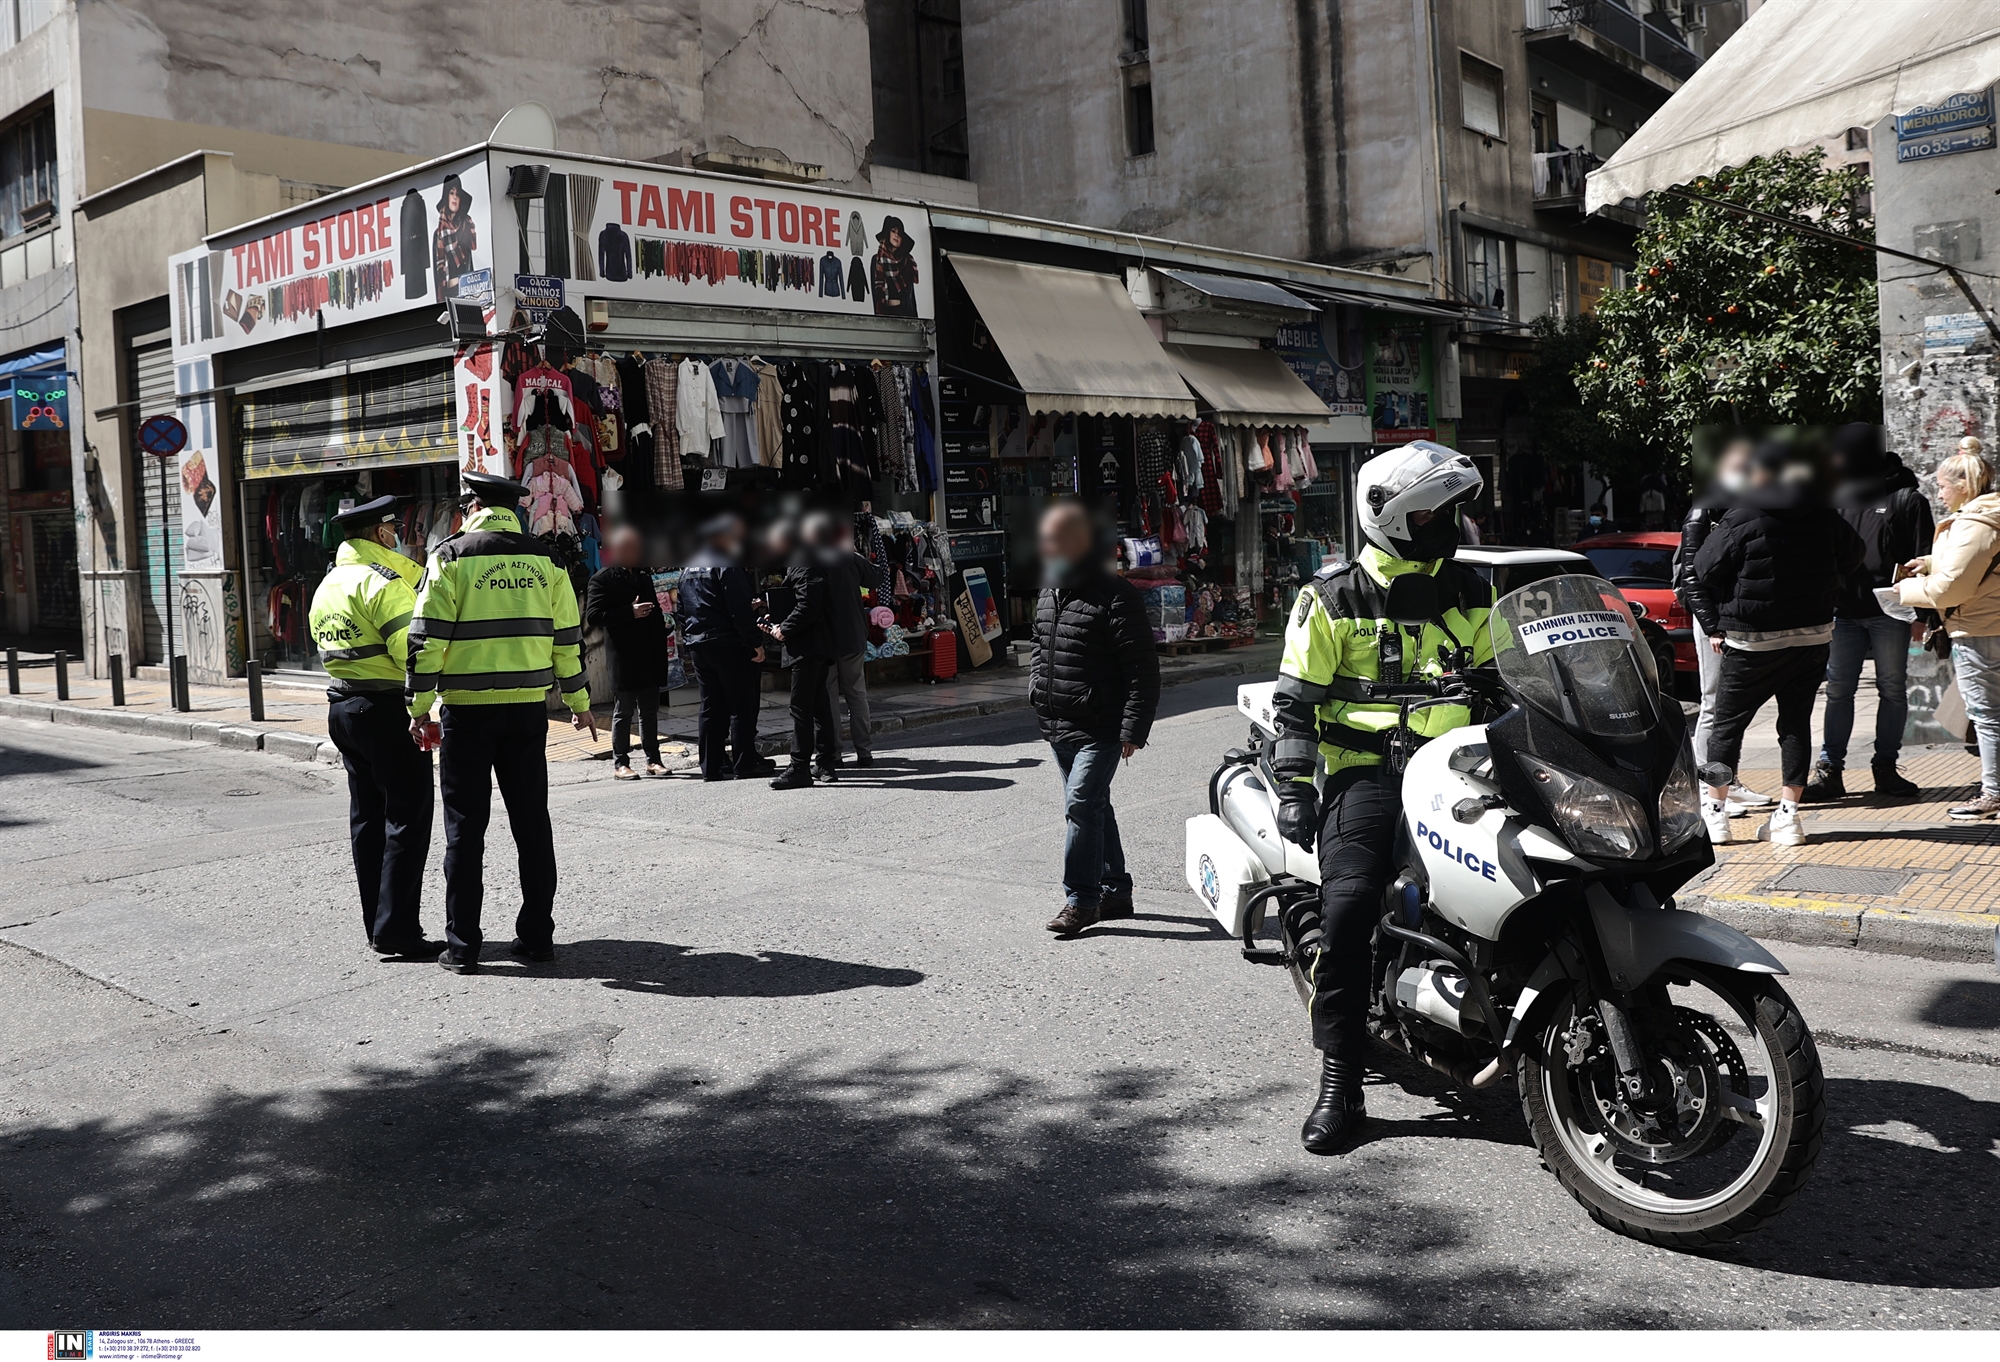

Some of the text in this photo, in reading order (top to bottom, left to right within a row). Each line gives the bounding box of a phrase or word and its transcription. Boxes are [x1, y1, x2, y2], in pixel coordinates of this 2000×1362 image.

[1903, 106, 1986, 130] MENANDROU
[1902, 131, 1990, 158] ΑΠΟ 53 55
[613, 179, 841, 248] TAMI STORE
[232, 197, 392, 290] TAMI STORE
[466, 274, 481, 284] ΟΔΟΣ
[529, 279, 550, 287] ΟΔΟΣ
[520, 286, 561, 297] ΖΗΝΩΝΟΣ
[521, 297, 560, 307] ZINONOS
[533, 312, 544, 322] 13
[1301, 362, 1315, 370] Mobile
[1373, 366, 1390, 374] MOBILE
[1395, 367, 1411, 375] LAPTOP
[1376, 376, 1387, 384] SALE
[1392, 376, 1410, 385] SERVICE
[487, 514, 512, 522] POLICE
[474, 561, 548, 590] ΕΛΛΗΝΙΚΗ ΑΣΤΥΝΟΜΙΑ
[490, 578, 533, 589] POLICE
[1521, 612, 1625, 636] ΕΛΛΗΝΙΚΗ ΑΣΤΥΝΟΜΙΑ
[319, 629, 352, 643] POLICE
[1353, 624, 1389, 638] POLICE
[1547, 626, 1620, 645] POLICE
[1609, 709, 1640, 720] SUZUKI
[1417, 820, 1497, 883] POLICE
[1527, 1069, 1580, 1185] TOURANCE
